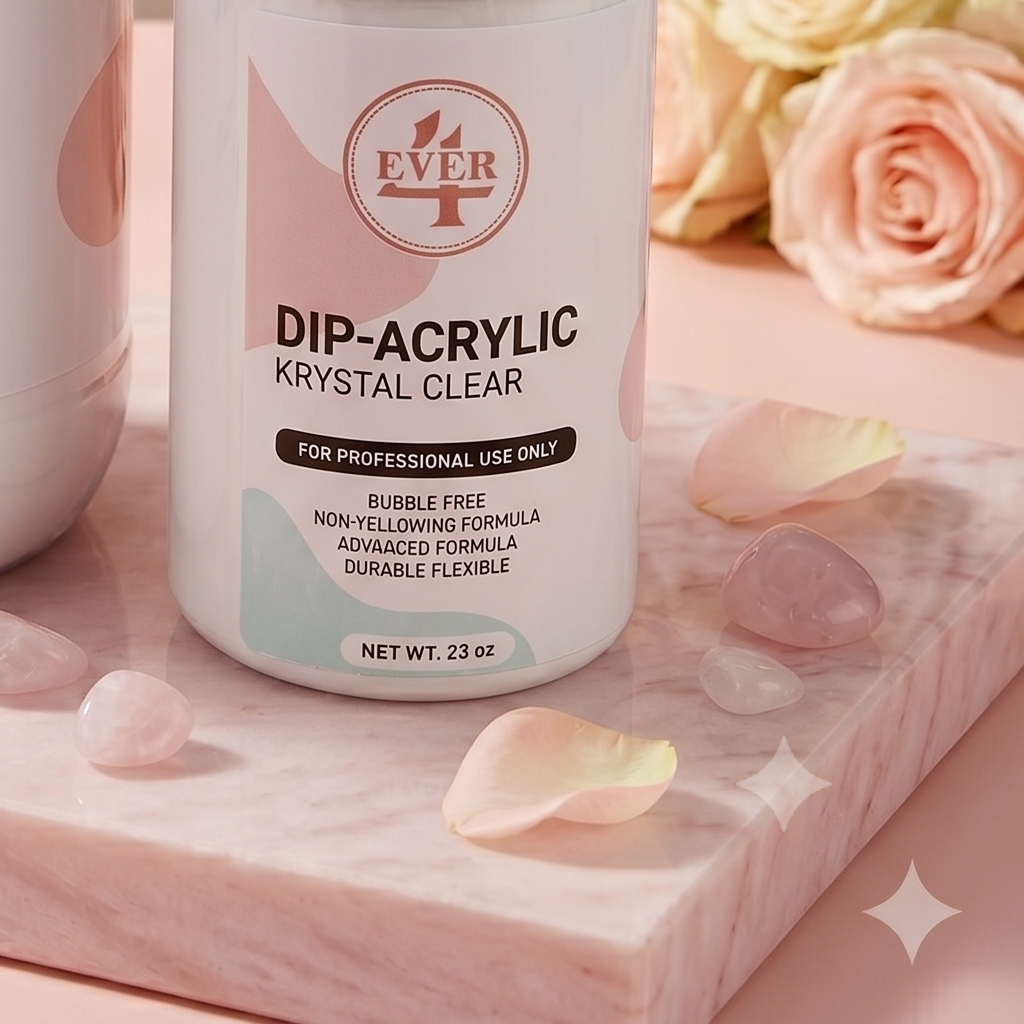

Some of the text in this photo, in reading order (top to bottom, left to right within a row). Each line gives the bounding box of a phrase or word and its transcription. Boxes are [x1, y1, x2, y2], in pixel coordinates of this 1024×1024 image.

[376, 150, 498, 182] EVER
[277, 304, 578, 362] DIP-ACRYLIC
[275, 356, 523, 401] KRYSTAL CLEAR
[298, 440, 558, 469] FOR PROFESSIONAL USE ONLY
[368, 493, 486, 511] BUBBLE FREE
[314, 508, 541, 533] NON-YELLOWING FORMULA
[436, 534, 518, 555] FORMULA
[344, 557, 510, 578] DURABLE FLEXIBLE
[361, 642, 495, 661] NET WT. 23 oz
